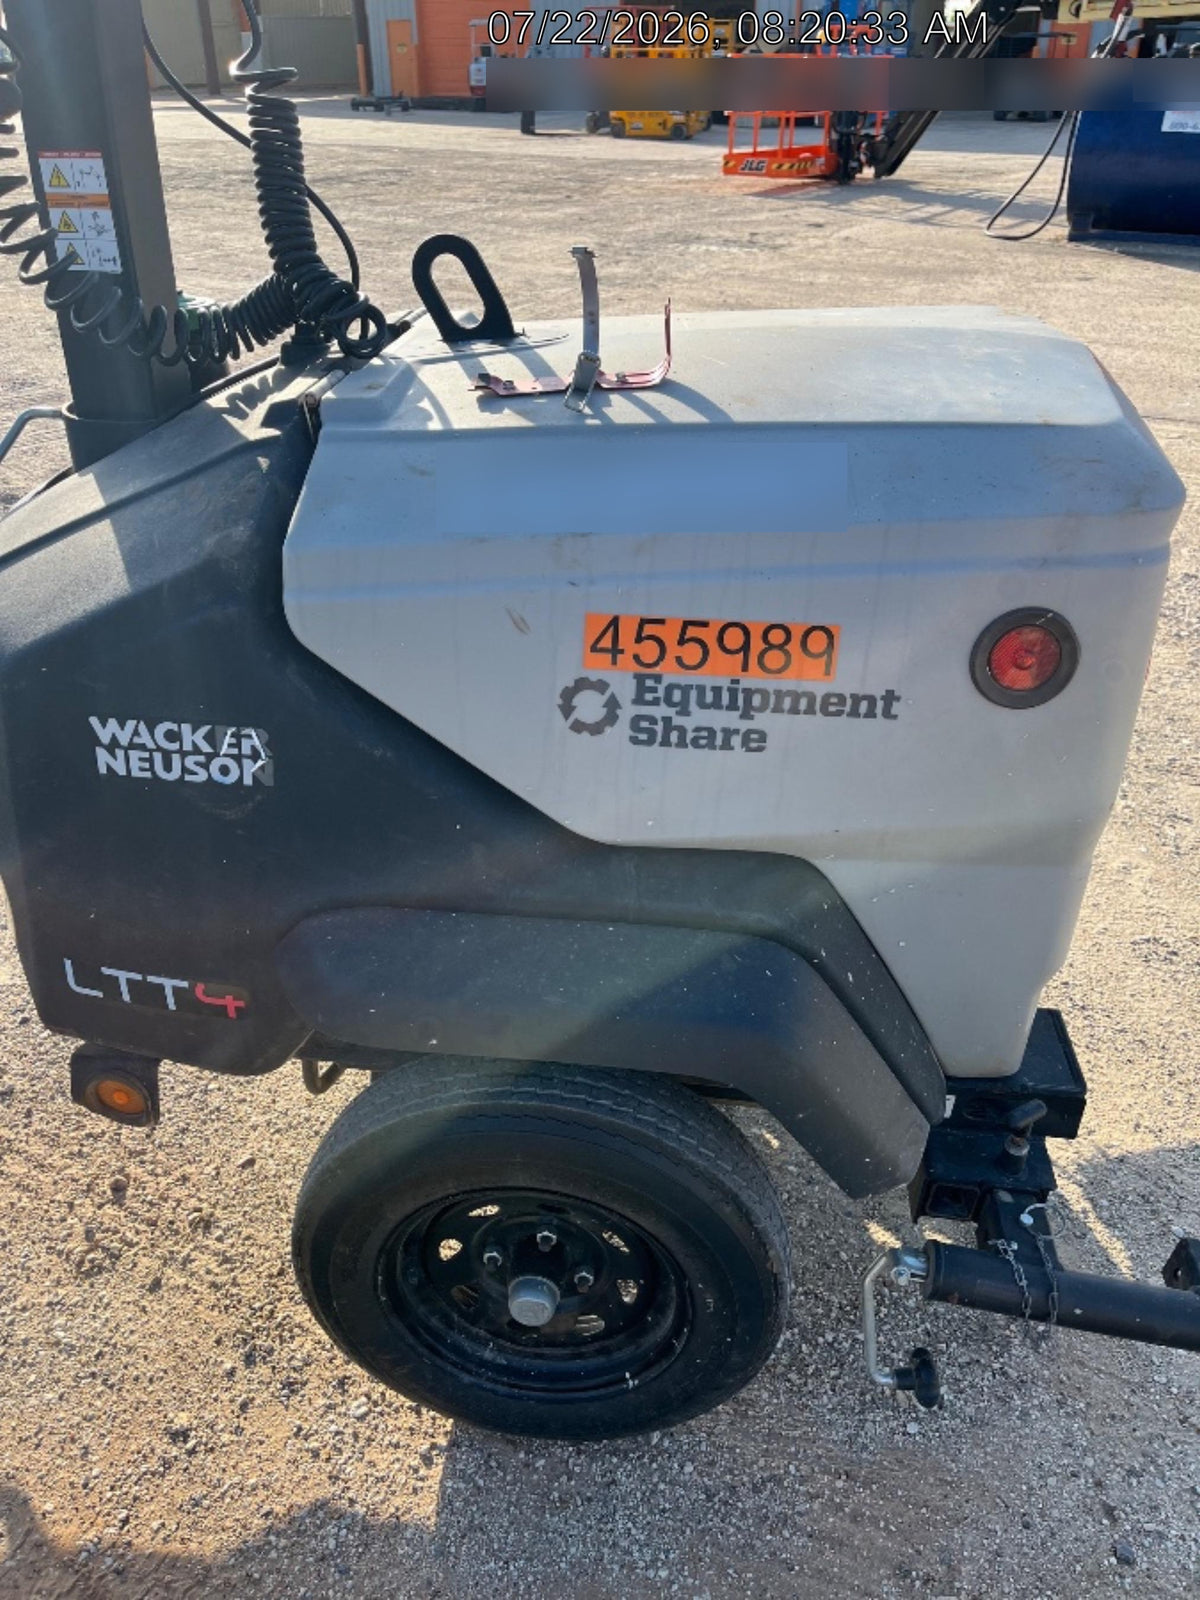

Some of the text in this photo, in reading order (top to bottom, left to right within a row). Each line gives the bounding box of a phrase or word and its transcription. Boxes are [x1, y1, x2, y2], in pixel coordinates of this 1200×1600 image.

[740, 158, 767, 173] JLG
[589, 615, 835, 676] 455989
[631, 673, 901, 720] Equipment
[88, 716, 273, 756] WACKER
[629, 714, 768, 752] Share
[95, 746, 275, 786] NEUSON
